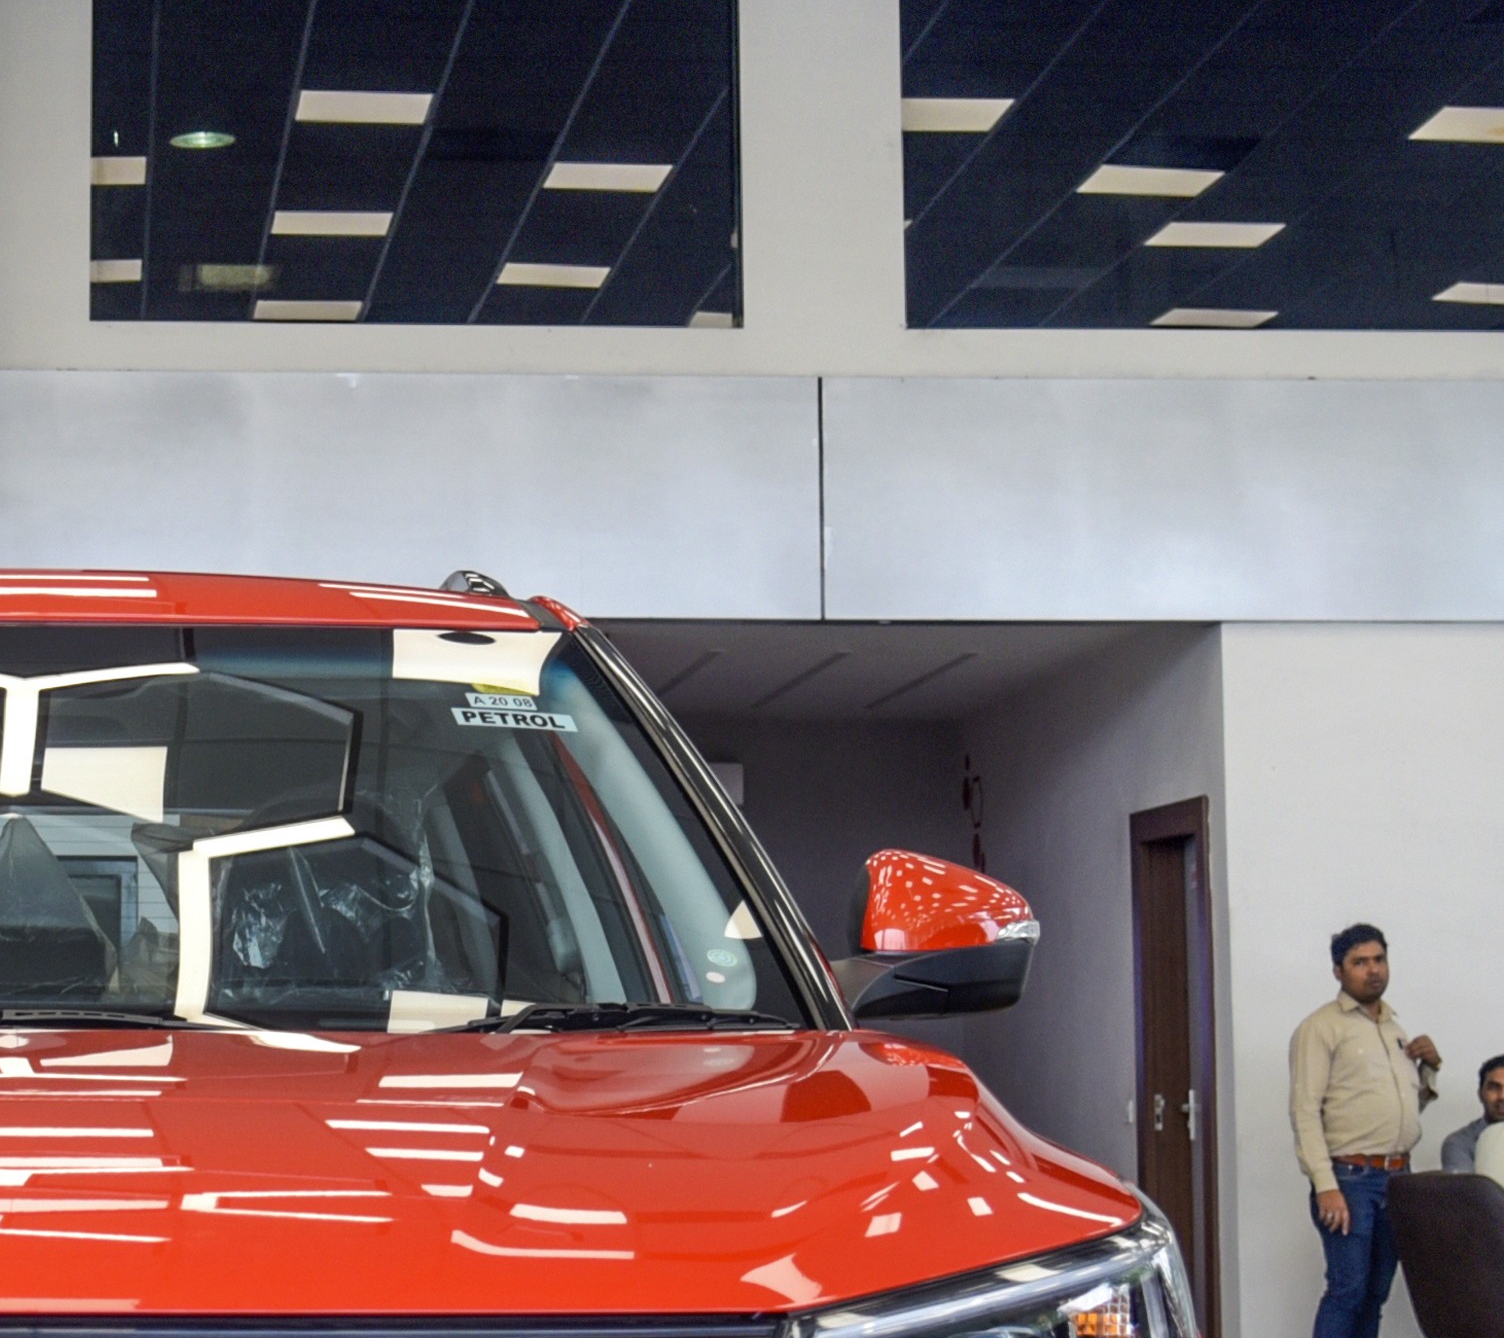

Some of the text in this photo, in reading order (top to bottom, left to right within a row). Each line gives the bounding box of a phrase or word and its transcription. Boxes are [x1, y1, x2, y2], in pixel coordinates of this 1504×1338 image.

[474, 696, 486, 704] A
[489, 696, 508, 706] 20
[461, 710, 566, 729] PETROL
